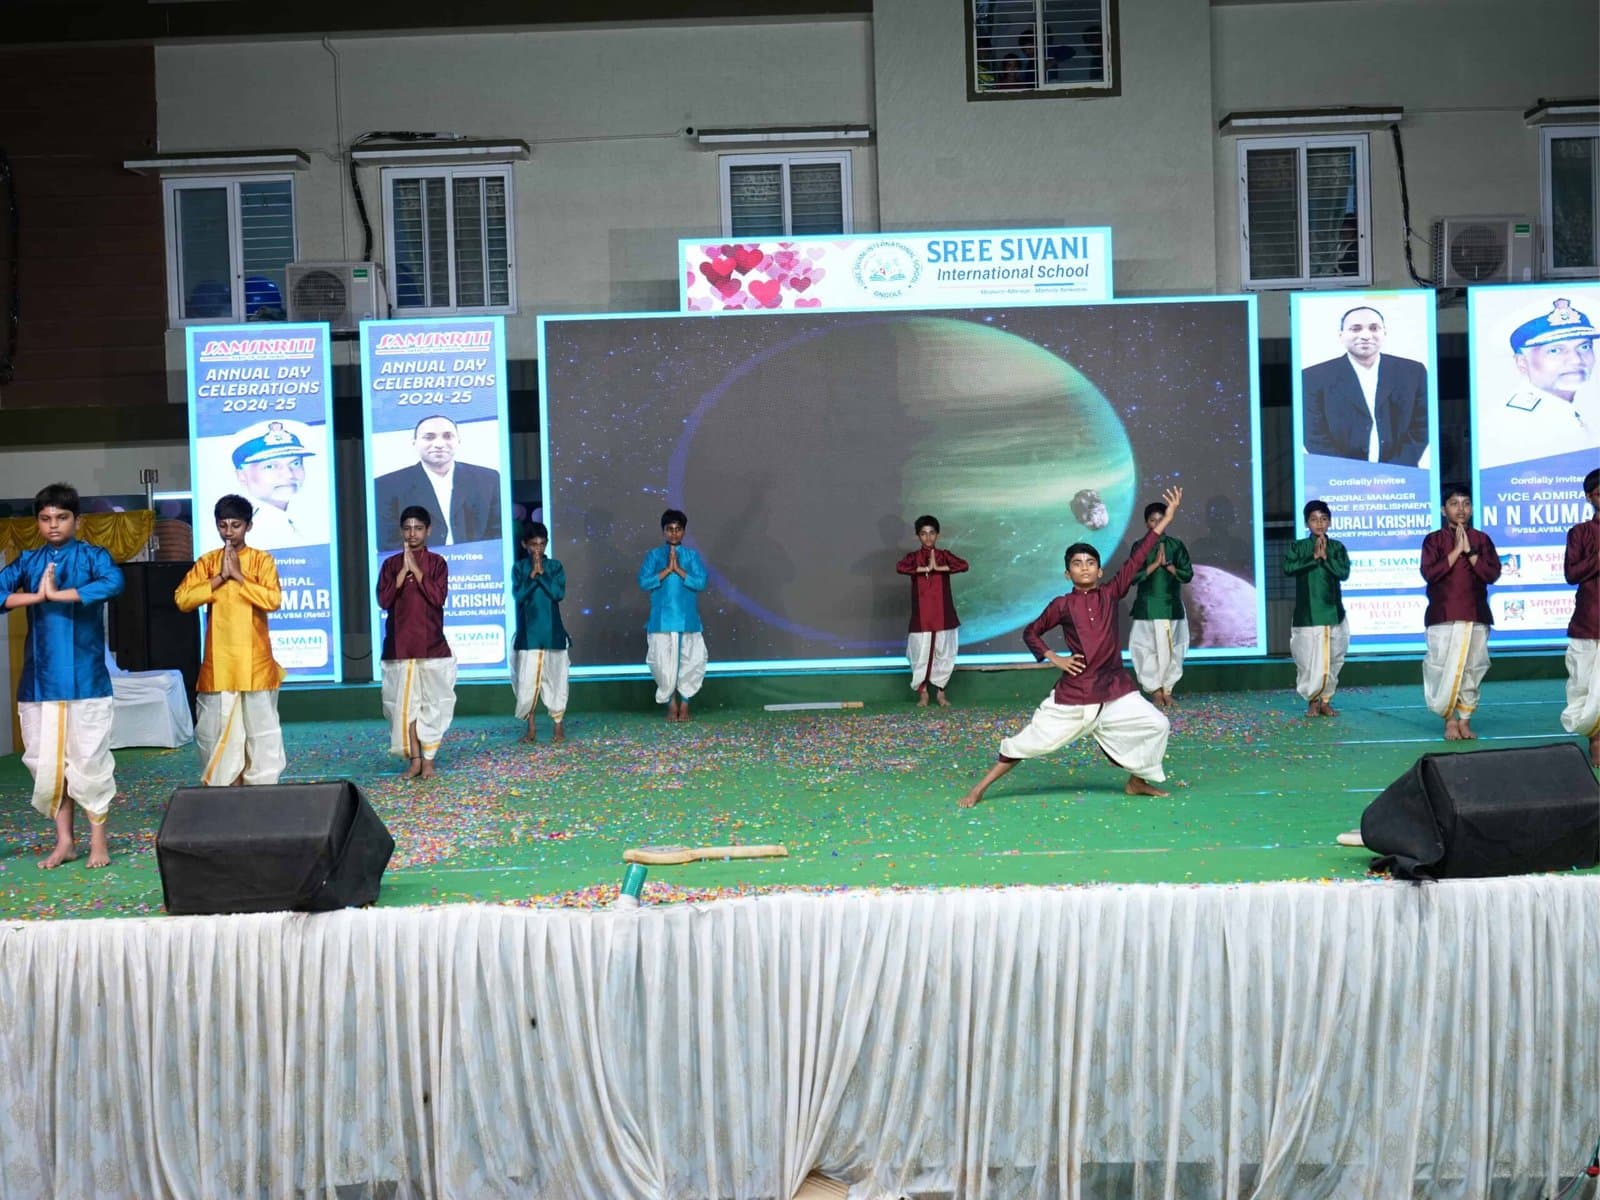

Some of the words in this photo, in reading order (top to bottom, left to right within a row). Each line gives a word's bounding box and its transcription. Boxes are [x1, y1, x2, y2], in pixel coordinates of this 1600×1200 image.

[927, 239, 993, 263] SREE
[1000, 236, 1089, 261] SIVANI
[937, 264, 1034, 281] International
[1037, 263, 1089, 278] School
[380, 360, 447, 374] ANNUAL
[453, 358, 487, 372] DAY
[205, 367, 271, 381] ANNUAL
[277, 366, 312, 379] DAY
[373, 374, 496, 391] CELEBRATIONS
[198, 381, 320, 398] CELEBRATIONS
[222, 398, 297, 412] 2024-25
[398, 391, 473, 406] 2024-25
[1329, 477, 1372, 487] Cordially
[1511, 477, 1554, 486] Cordially
[1367, 493, 1416, 501] MANAGER
[1497, 492, 1530, 502] VICE
[1533, 490, 1586, 500] ADMIRA
[1483, 505, 1498, 526] N
[1506, 504, 1521, 525] N
[1529, 503, 1595, 525] KUMA
[451, 553, 483, 561] Invites
[1350, 560, 1376, 568] REE
[1379, 558, 1419, 566] SIVAN
[1527, 553, 1564, 562] YASH
[281, 589, 330, 610] MAR
[1543, 607, 1573, 615] SCHO
[277, 636, 323, 645] SIVANI
[455, 632, 499, 641] SIVANI
